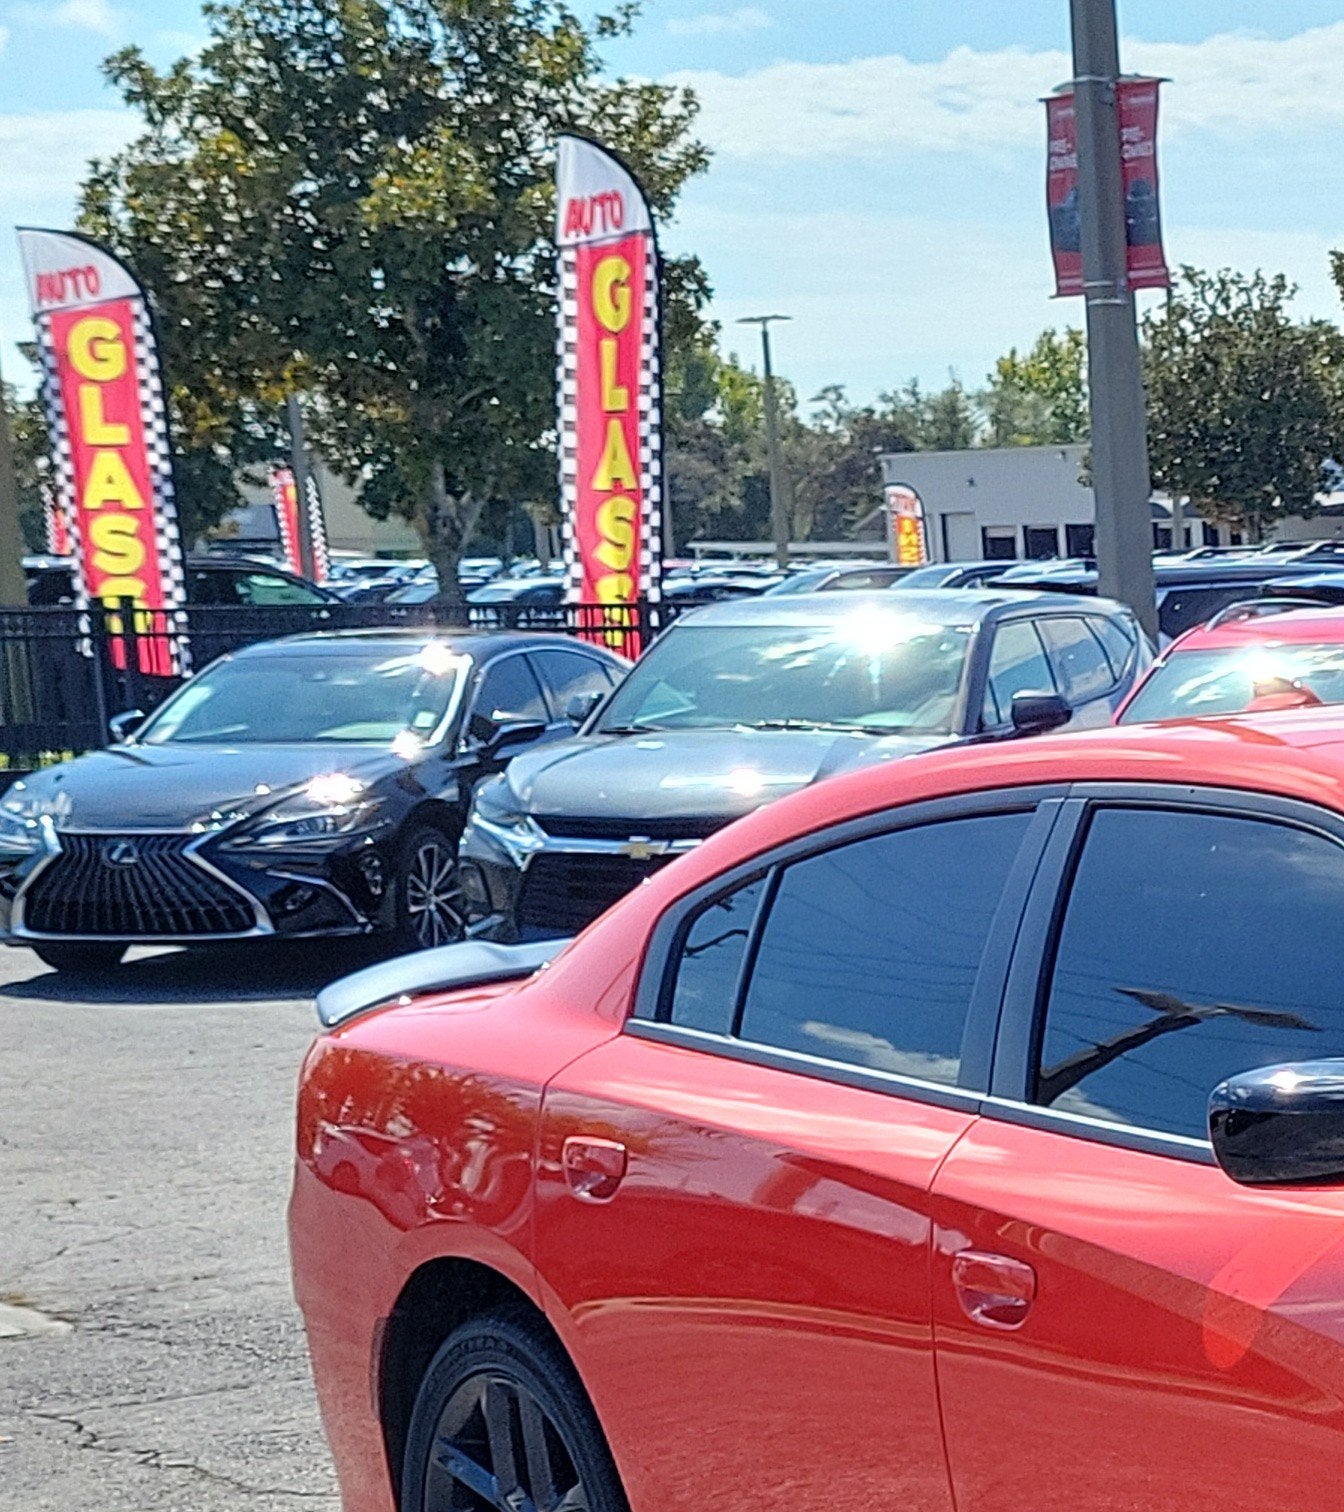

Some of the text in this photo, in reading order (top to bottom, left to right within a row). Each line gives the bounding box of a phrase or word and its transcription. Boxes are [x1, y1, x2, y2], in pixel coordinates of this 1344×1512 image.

[566, 189, 624, 238] AUTO
[36, 265, 100, 306] AUTO
[591, 256, 638, 648] GLASS
